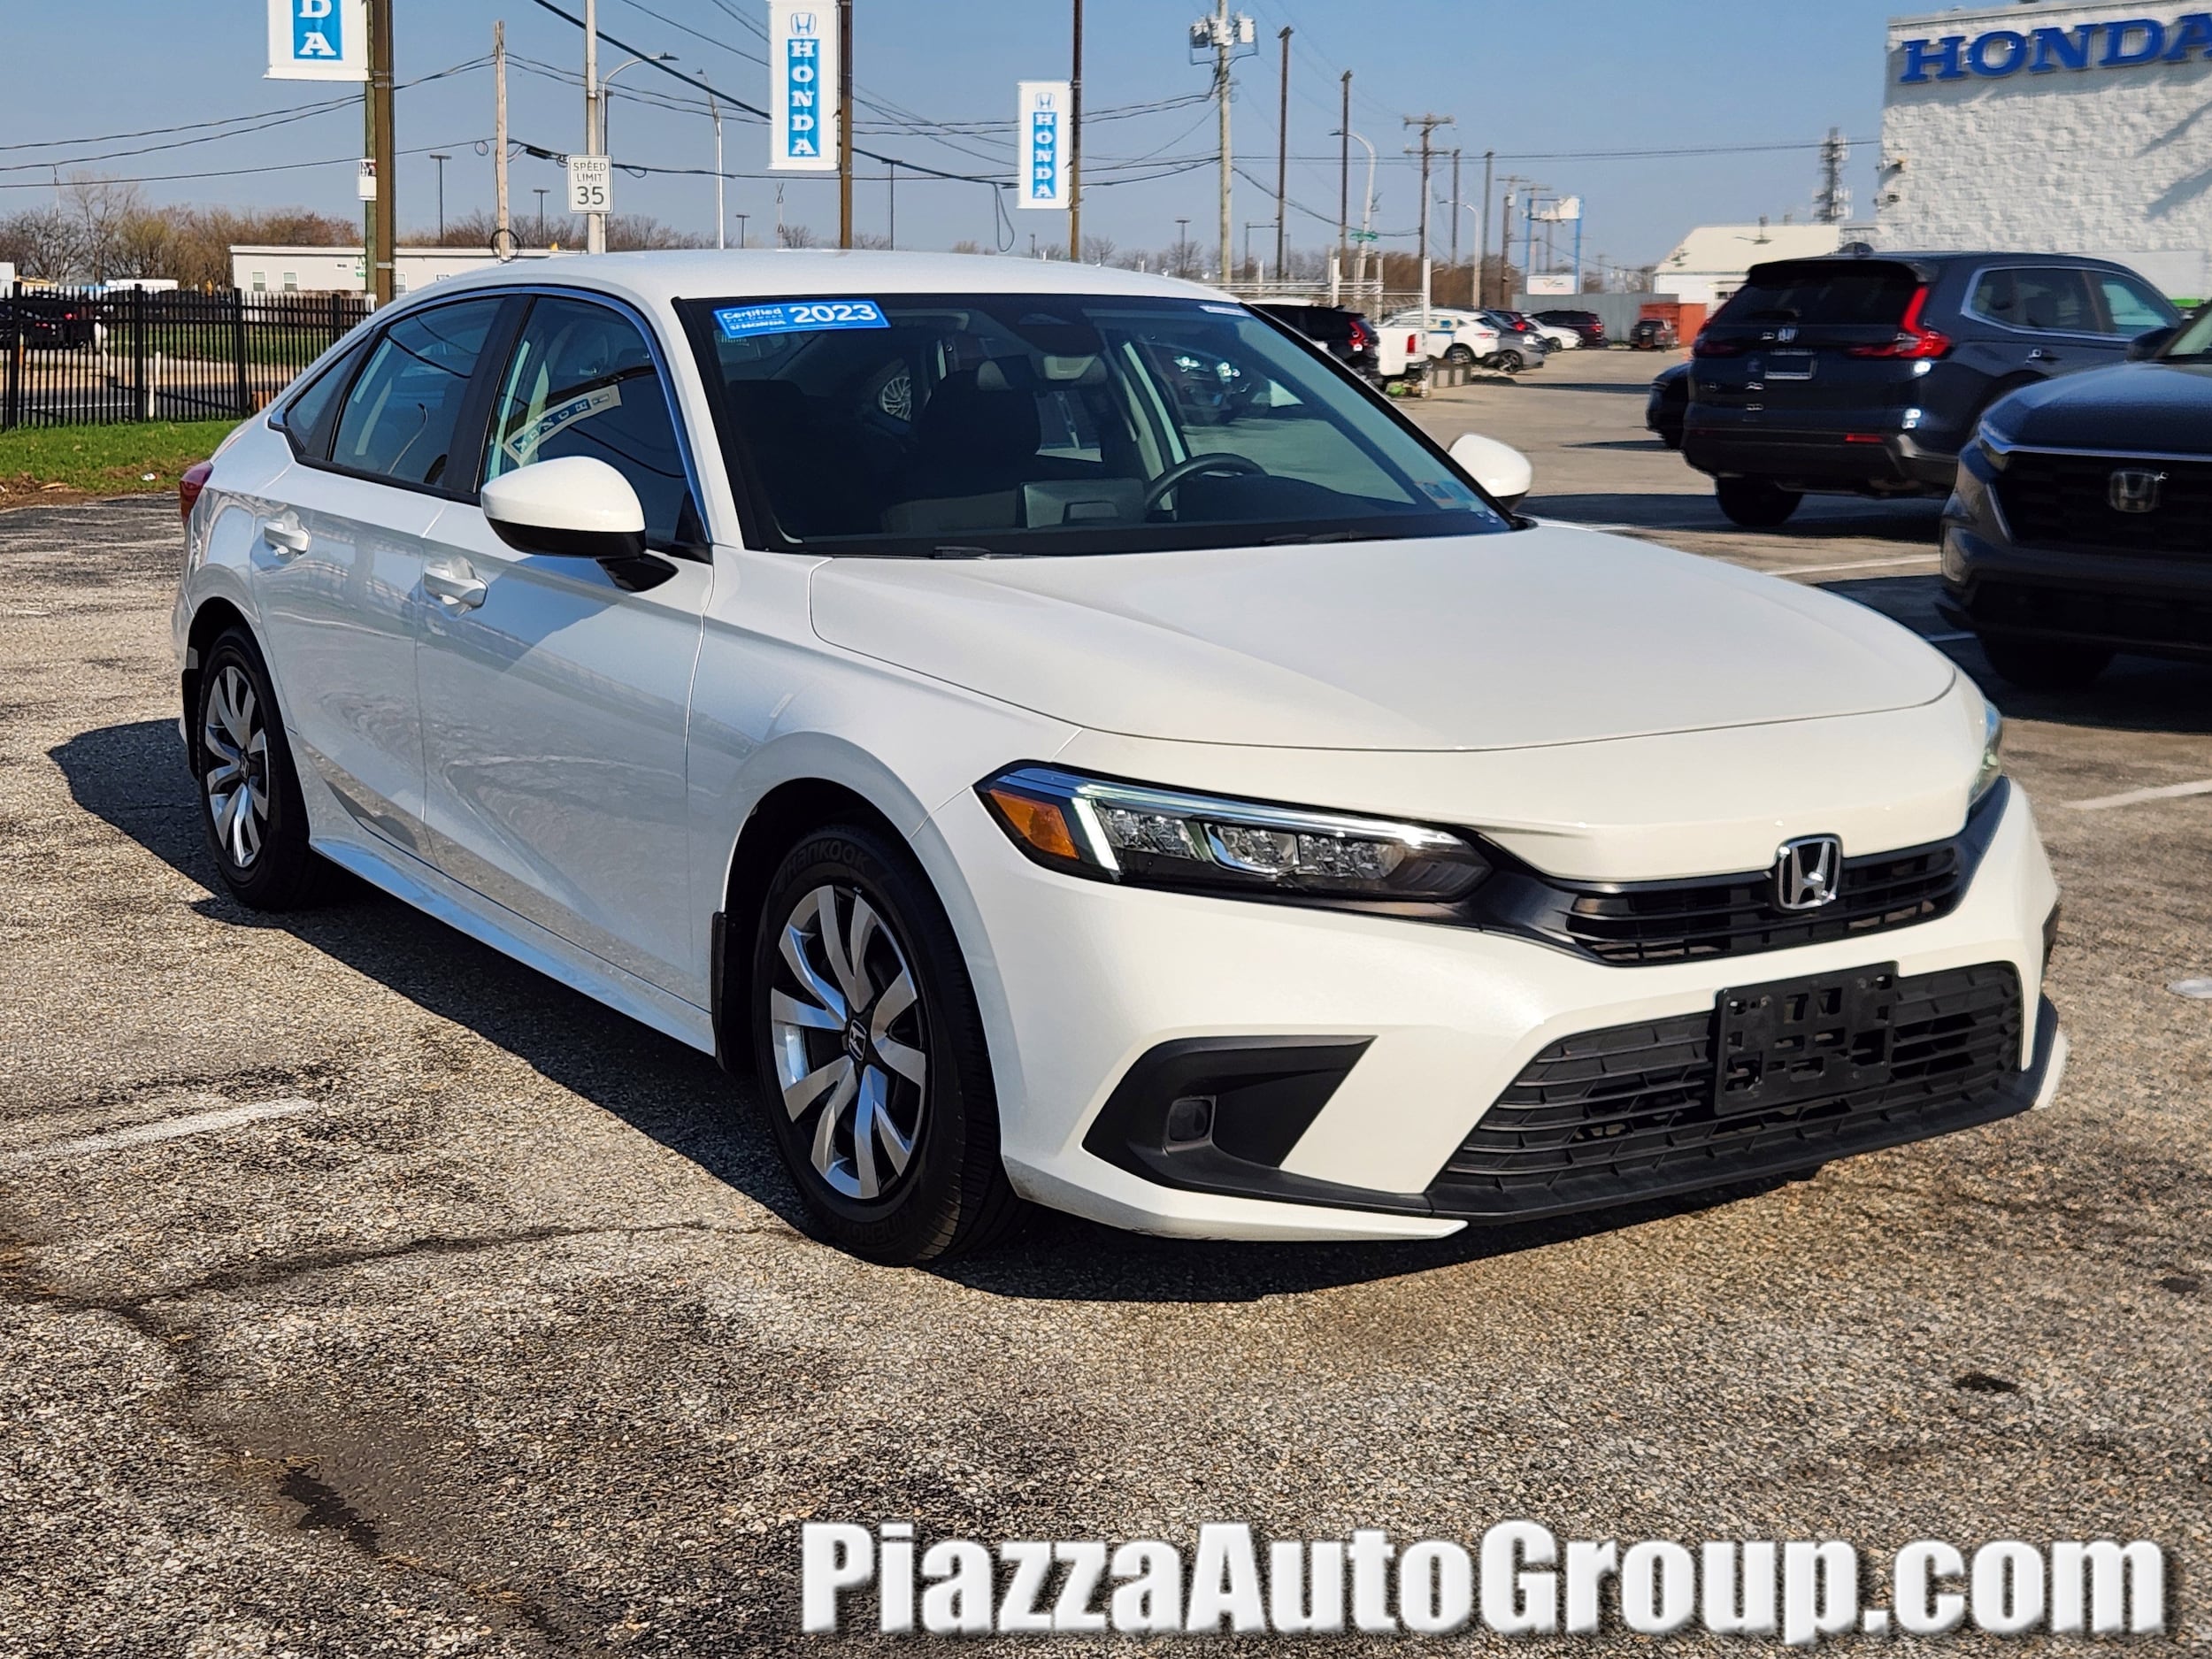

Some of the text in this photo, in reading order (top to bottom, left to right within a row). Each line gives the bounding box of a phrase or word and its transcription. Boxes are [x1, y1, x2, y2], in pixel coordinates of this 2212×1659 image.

[1900, 12, 2212, 82] HONDA
[791, 41, 816, 155] HONDA
[1034, 113, 1054, 197] HONDA
[572, 162, 607, 172] SPEED
[576, 173, 603, 182] LIMIT
[577, 186, 604, 205] 35
[722, 307, 782, 319] Certified
[789, 304, 878, 324] 2023
